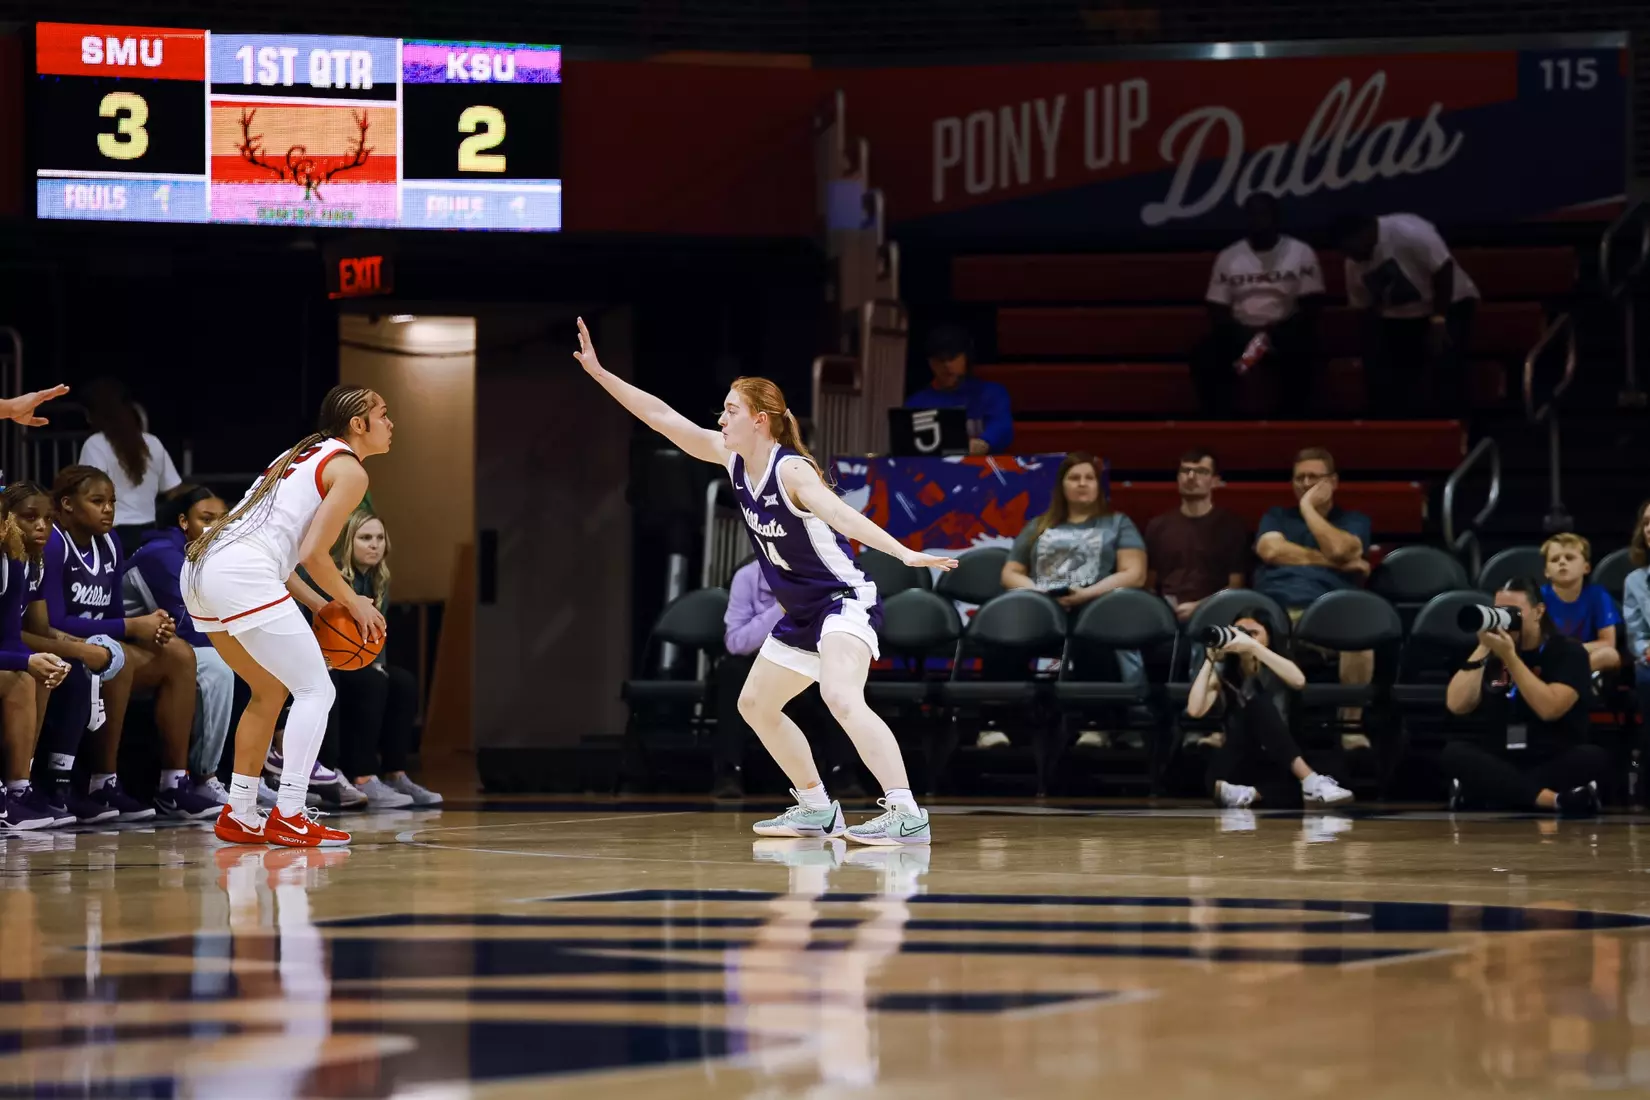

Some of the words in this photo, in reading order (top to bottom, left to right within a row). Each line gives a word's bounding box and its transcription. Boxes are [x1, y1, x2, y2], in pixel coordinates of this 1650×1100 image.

[82, 36, 164, 67] SMU
[235, 45, 299, 87] 1ST
[309, 48, 373, 90] QTR
[447, 52, 515, 82] KSU
[1538, 57, 1600, 92] 115
[97, 91, 149, 160] 3
[458, 104, 507, 172] 2
[932, 93, 1067, 204] PONY
[1084, 76, 1150, 171] UP
[1140, 69, 1465, 228] Dallas
[64, 183, 127, 211] FOULS
[153, 184, 171, 214] 1
[339, 255, 383, 292] EXIT
